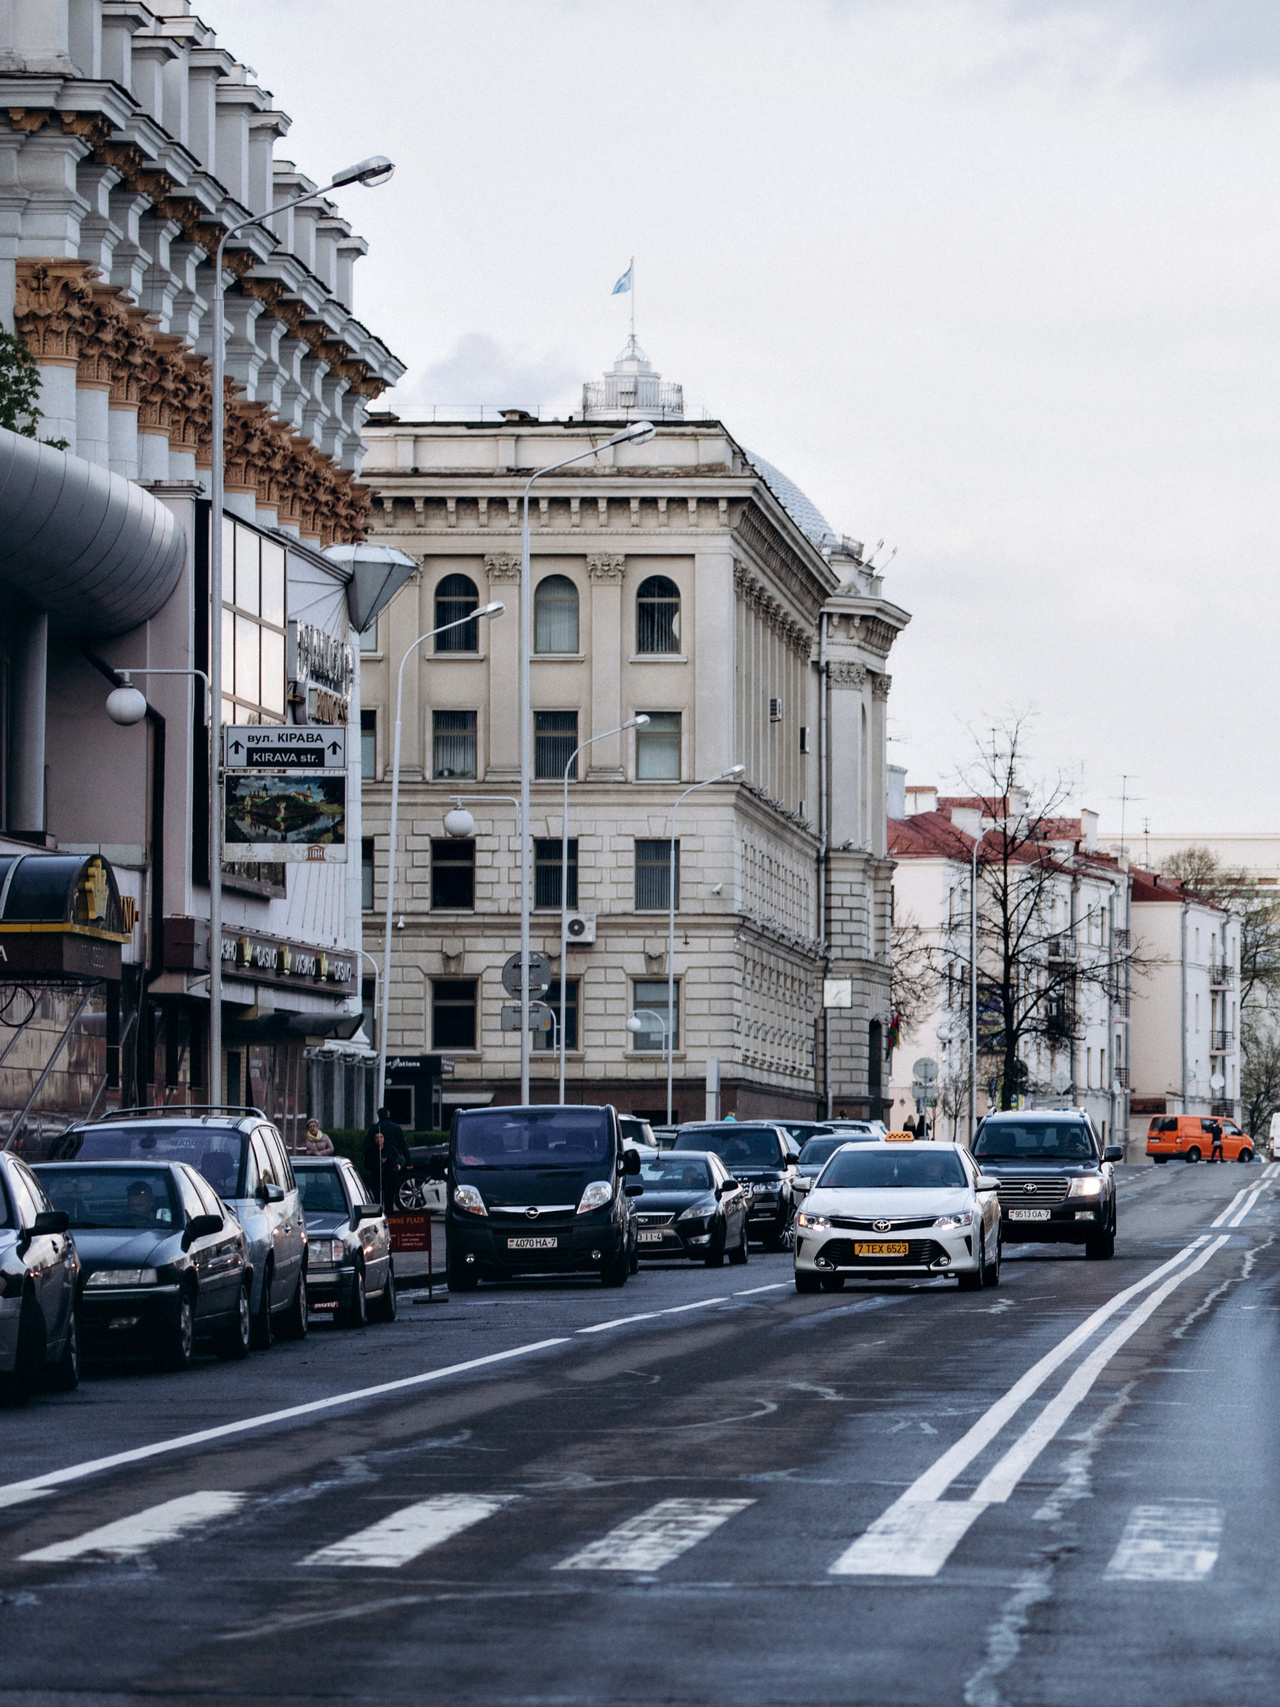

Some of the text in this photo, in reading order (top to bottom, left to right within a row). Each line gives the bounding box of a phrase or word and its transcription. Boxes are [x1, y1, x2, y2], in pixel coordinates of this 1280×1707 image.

[247, 733, 324, 745] вул. КІРАВА
[253, 752, 319, 762] KIRAVA str.
[1015, 1210, 1050, 1218] 9513 OA-7
[515, 1238, 556, 1248] 4070 HA-7
[858, 1244, 907, 1254] 7 TEX 6523
